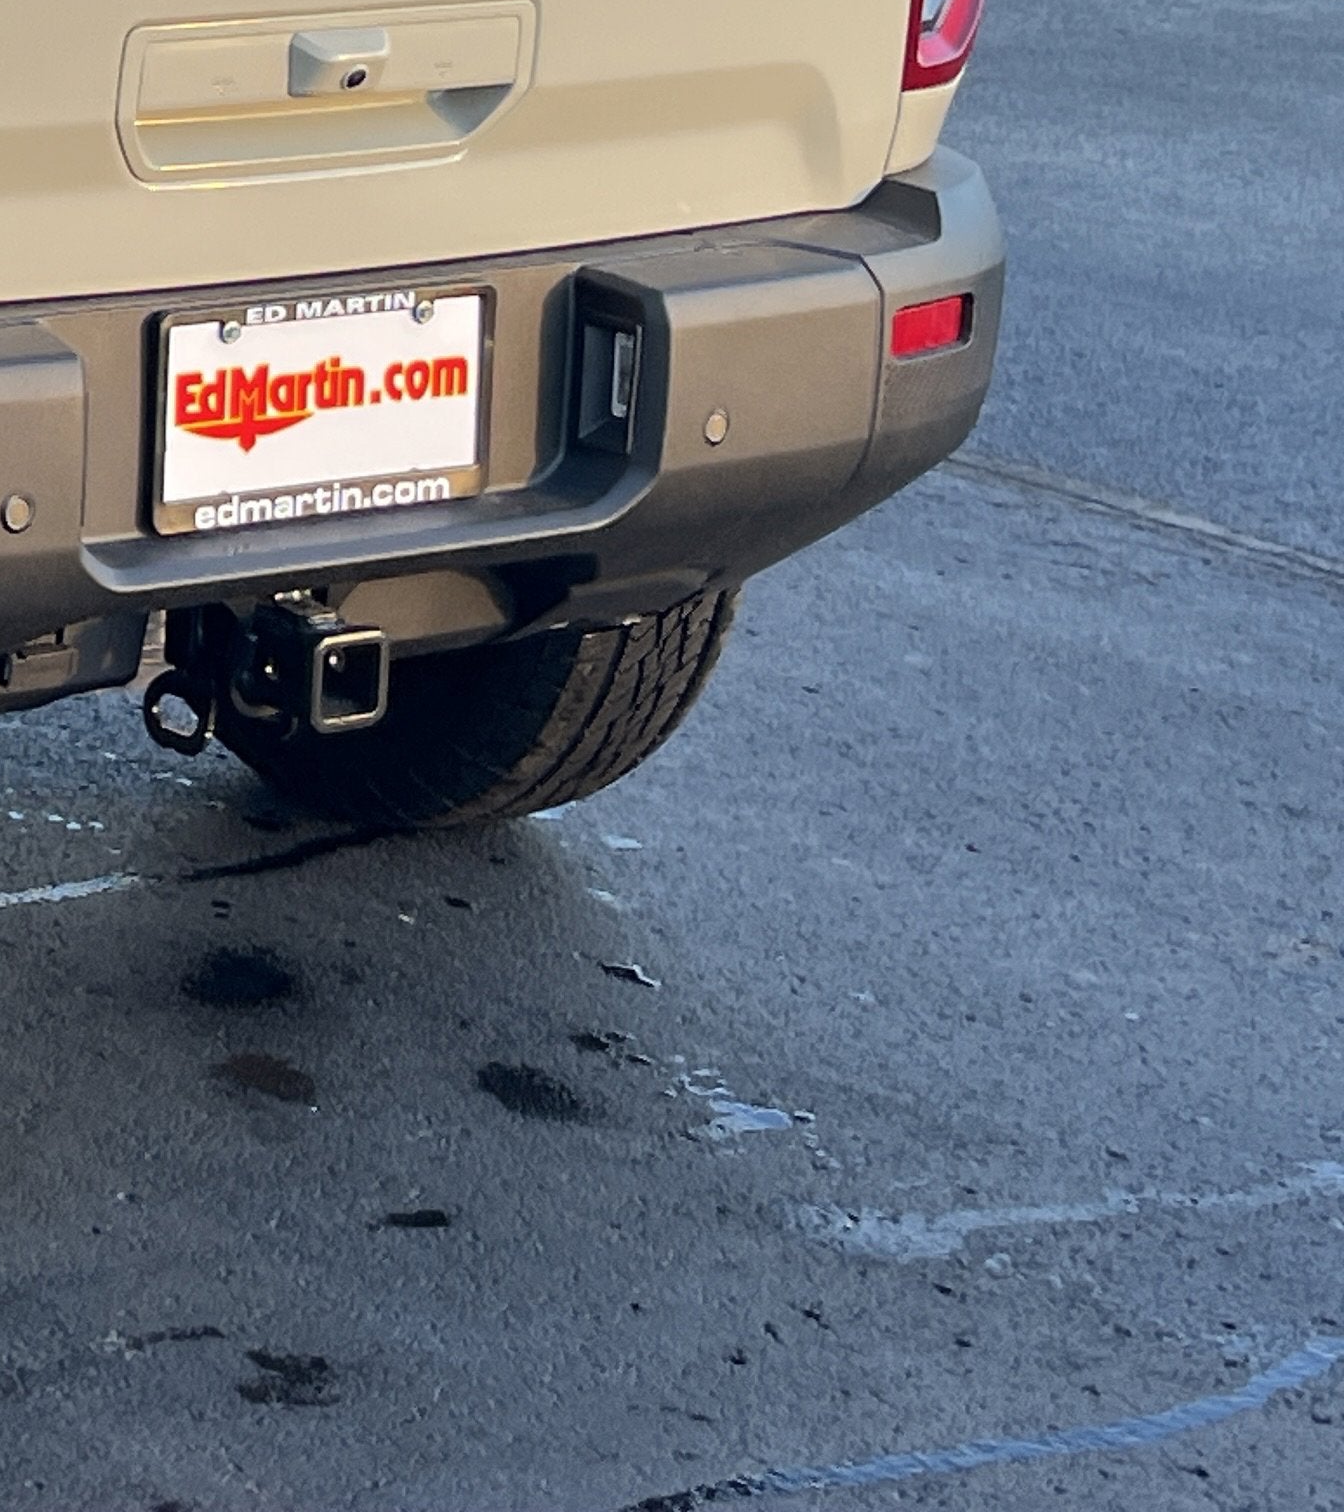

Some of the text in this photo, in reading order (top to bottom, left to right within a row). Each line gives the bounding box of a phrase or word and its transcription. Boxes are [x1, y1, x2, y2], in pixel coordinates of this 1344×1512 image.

[246, 291, 416, 325] ED MARTIN
[194, 476, 450, 530] edmartin.com
